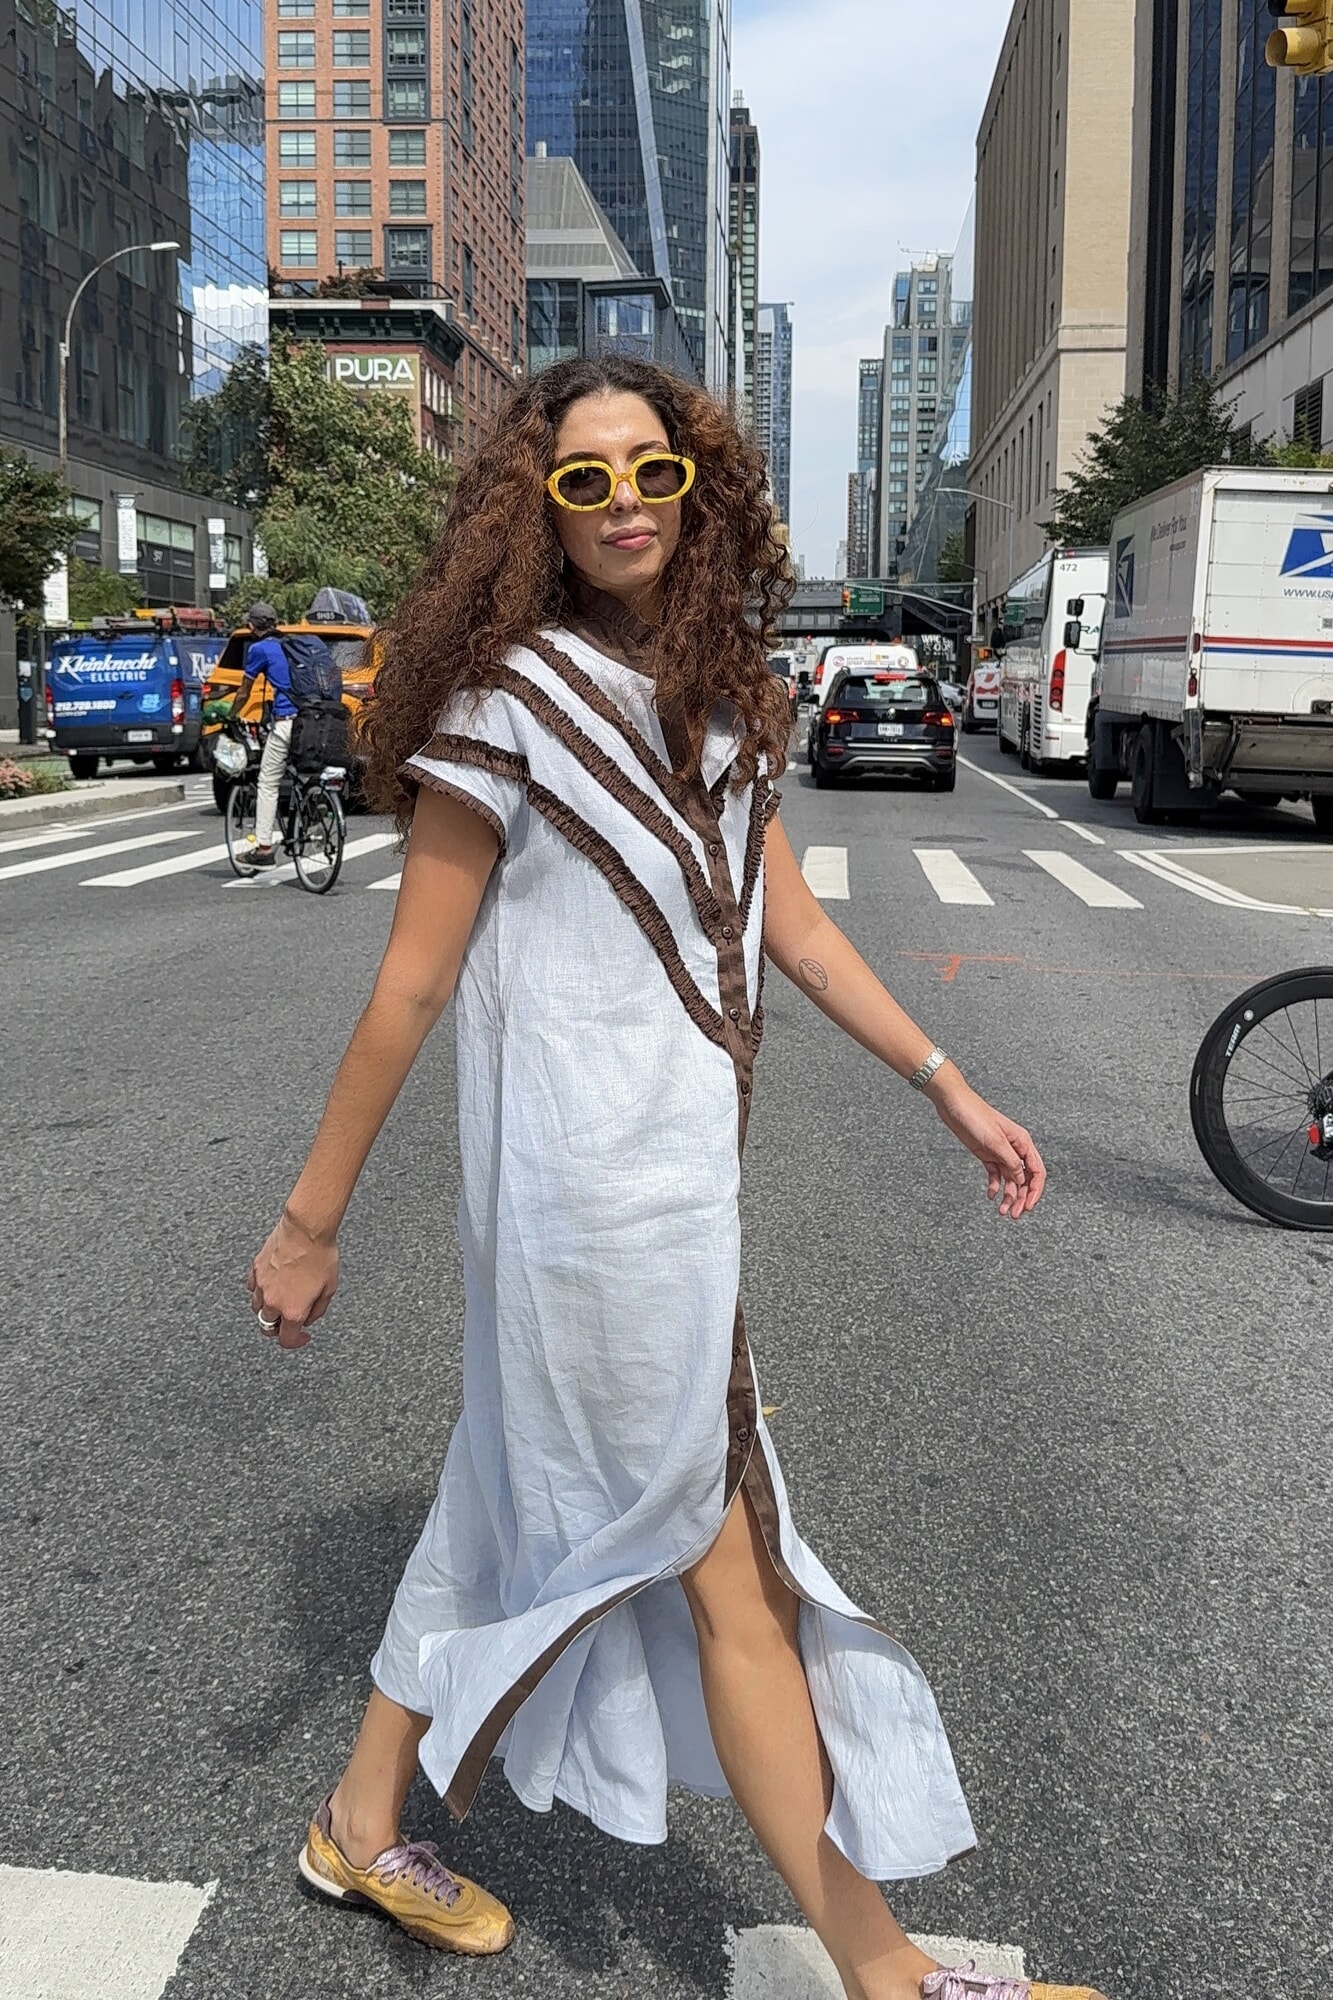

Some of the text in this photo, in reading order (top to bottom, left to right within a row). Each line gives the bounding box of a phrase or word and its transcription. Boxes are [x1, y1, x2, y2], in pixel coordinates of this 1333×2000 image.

[335, 357, 415, 382] PURA
[1059, 563, 1078, 572] 472
[55, 652, 158, 684] Kleinknecht
[90, 671, 148, 683] ELECTRIC
